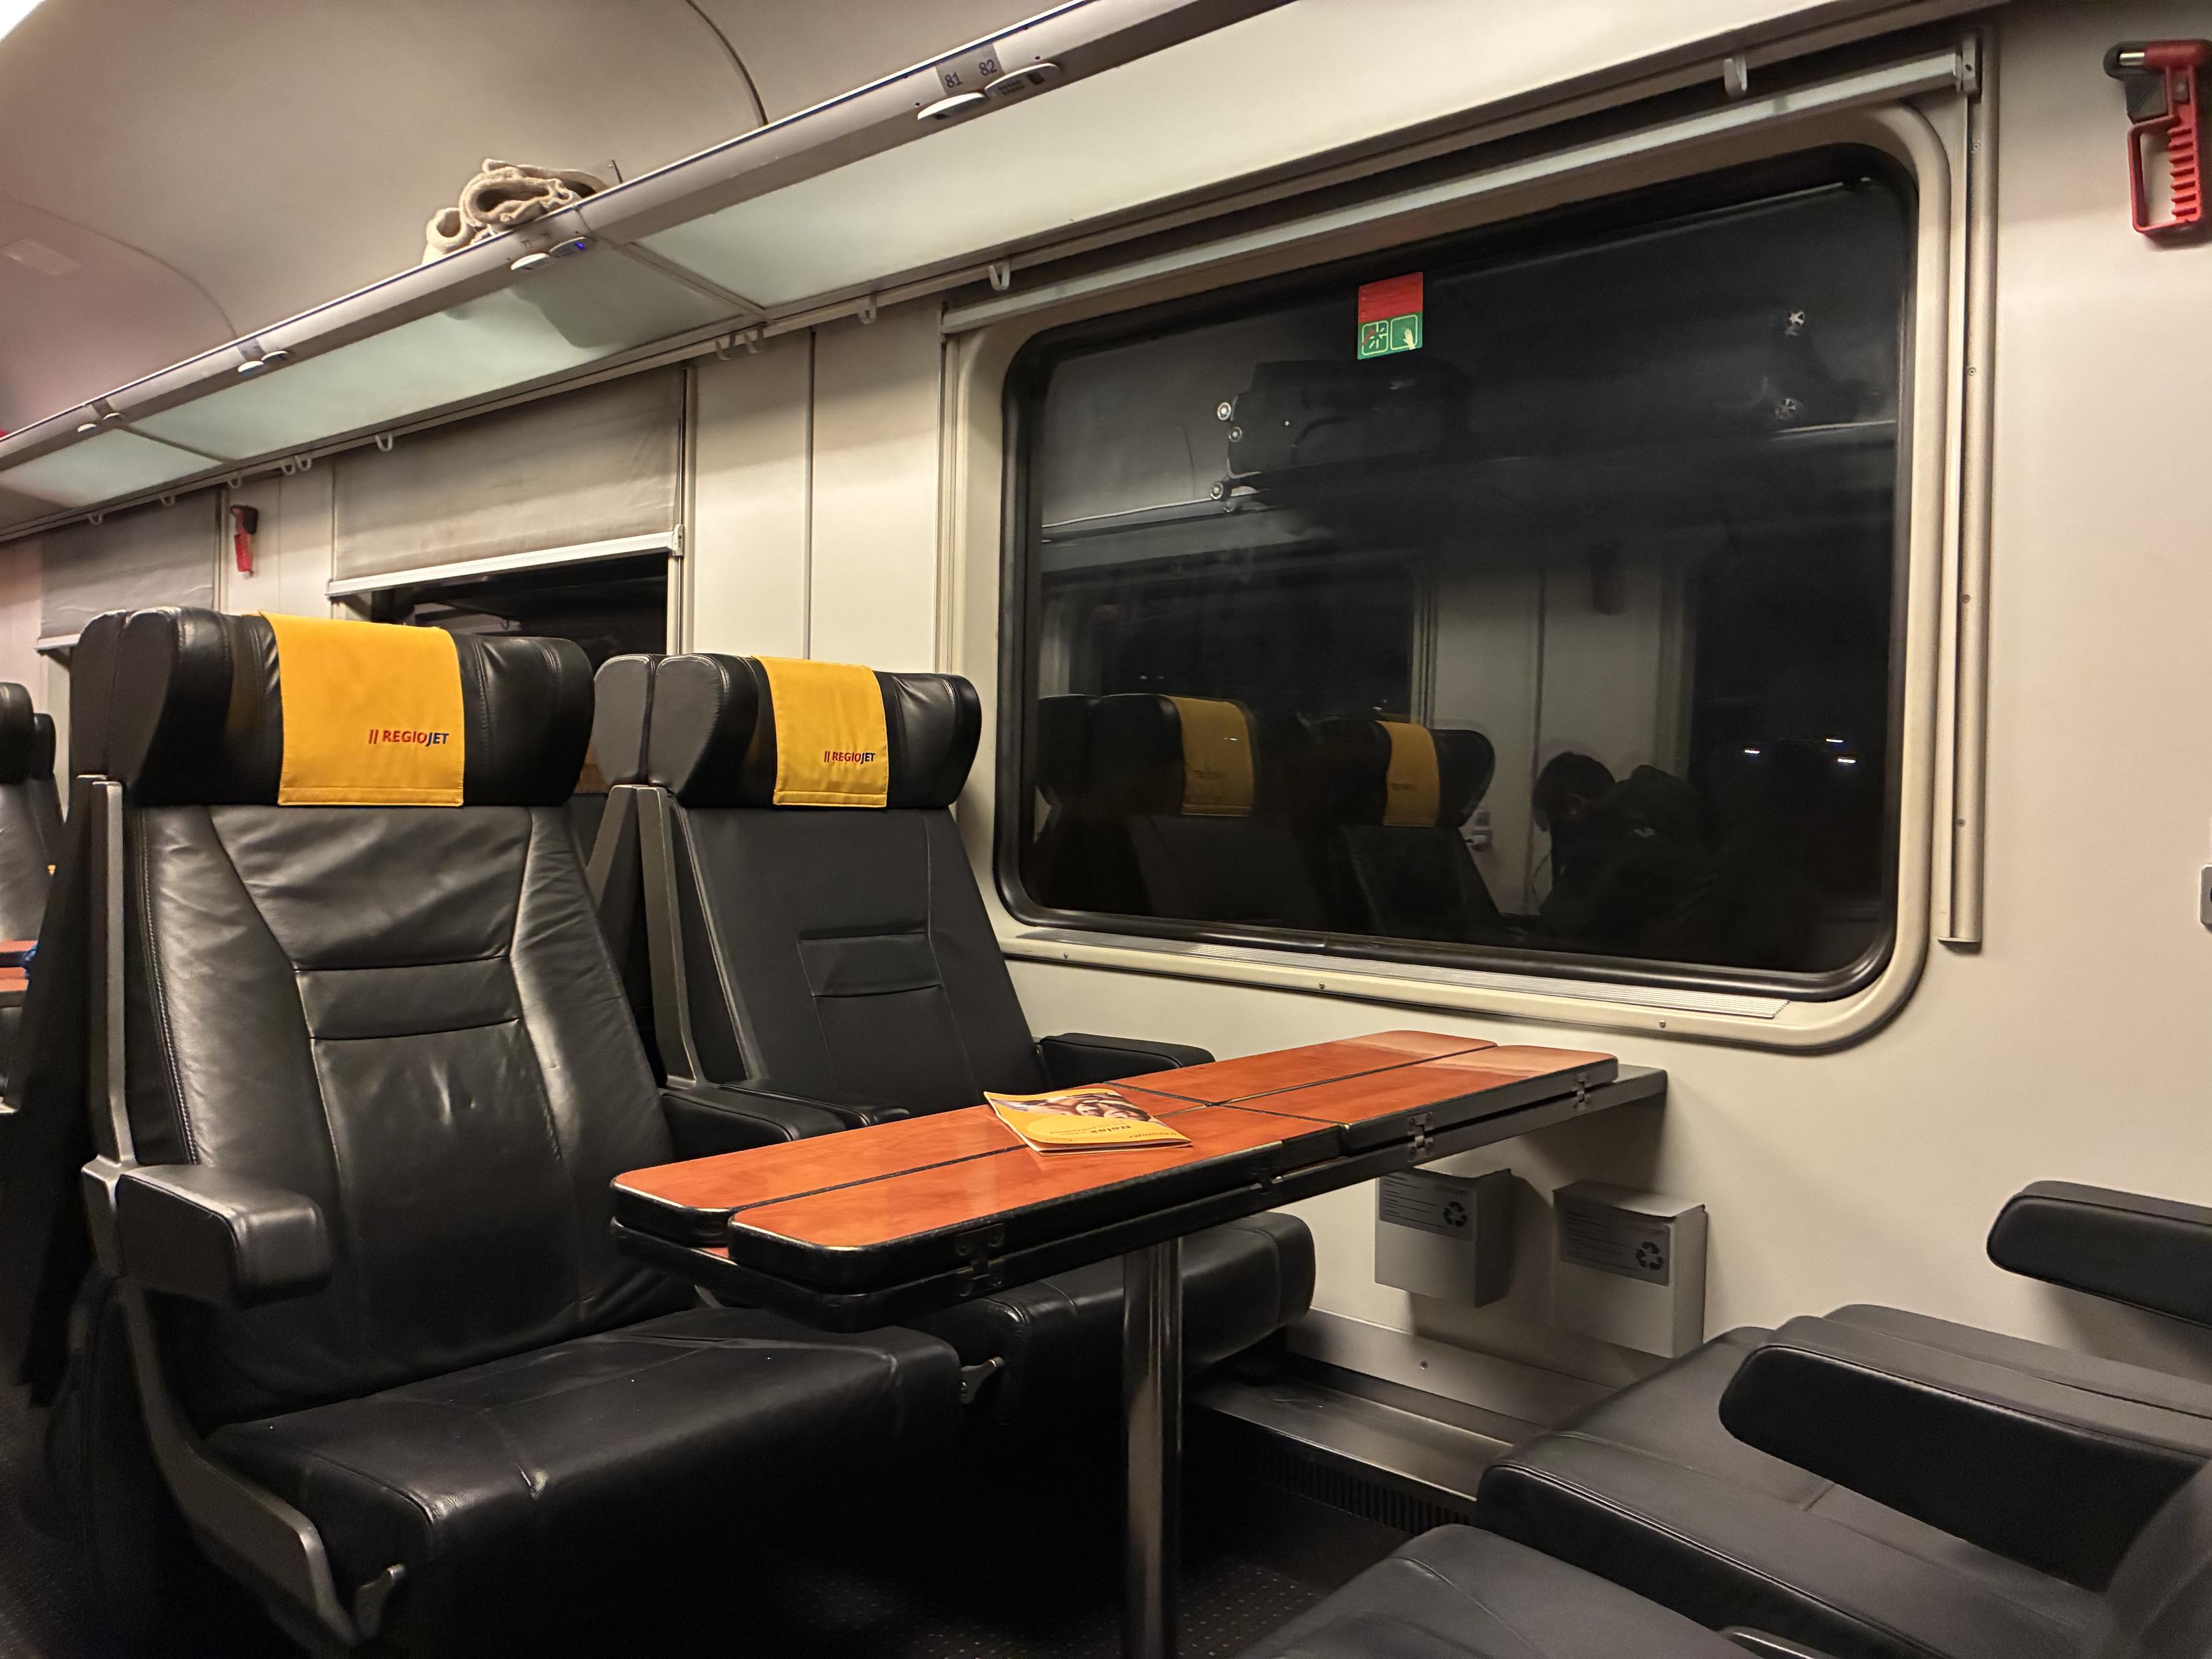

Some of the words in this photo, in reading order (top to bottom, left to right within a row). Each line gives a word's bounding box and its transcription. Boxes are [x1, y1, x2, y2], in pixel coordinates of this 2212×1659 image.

[945, 72, 963, 88] 81
[979, 59, 997, 76] 82
[383, 730, 449, 747] REGIOJET
[832, 751, 875, 764] REGIOJET
[1090, 1125, 1131, 1133] Relax
